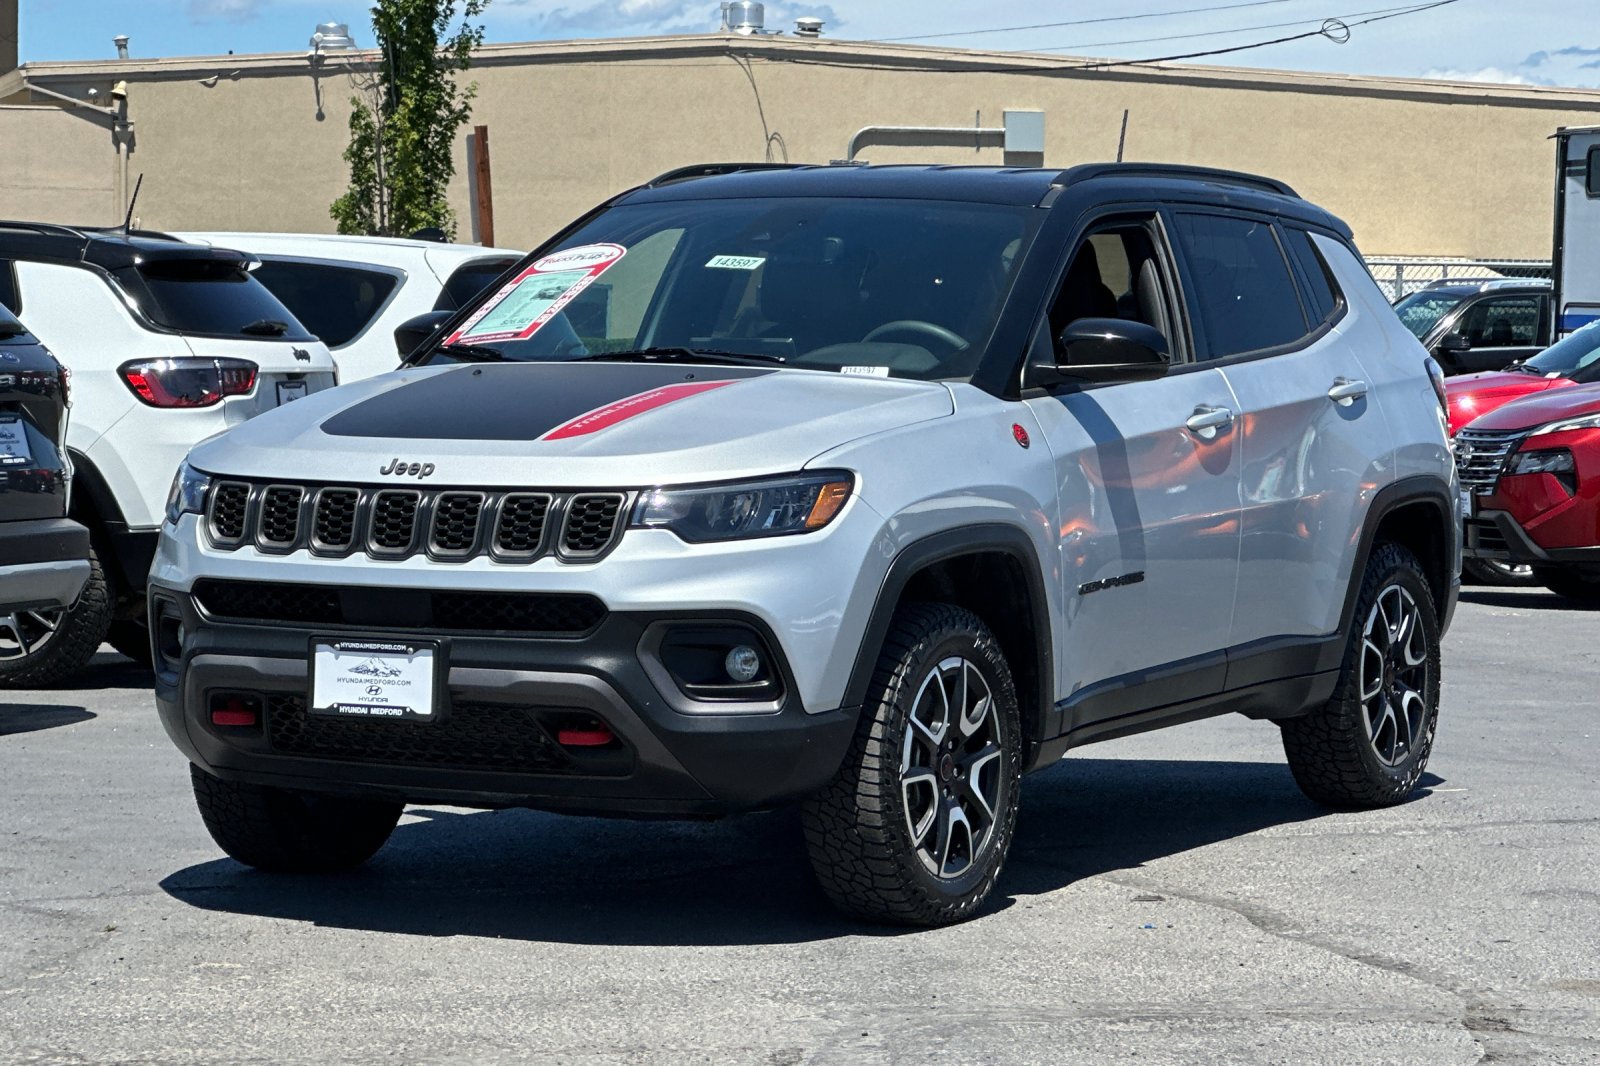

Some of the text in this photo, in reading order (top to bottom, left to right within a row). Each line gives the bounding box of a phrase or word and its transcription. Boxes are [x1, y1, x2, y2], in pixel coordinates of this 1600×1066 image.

[714, 257, 760, 267] 143597
[380, 458, 436, 480] Jeep
[340, 642, 407, 651] HYUNDAIMEDFORD.COM
[336, 677, 411, 686] HYUNDAIMEDFORD.COM
[339, 705, 403, 716] HYUNDAI MEDFORD
